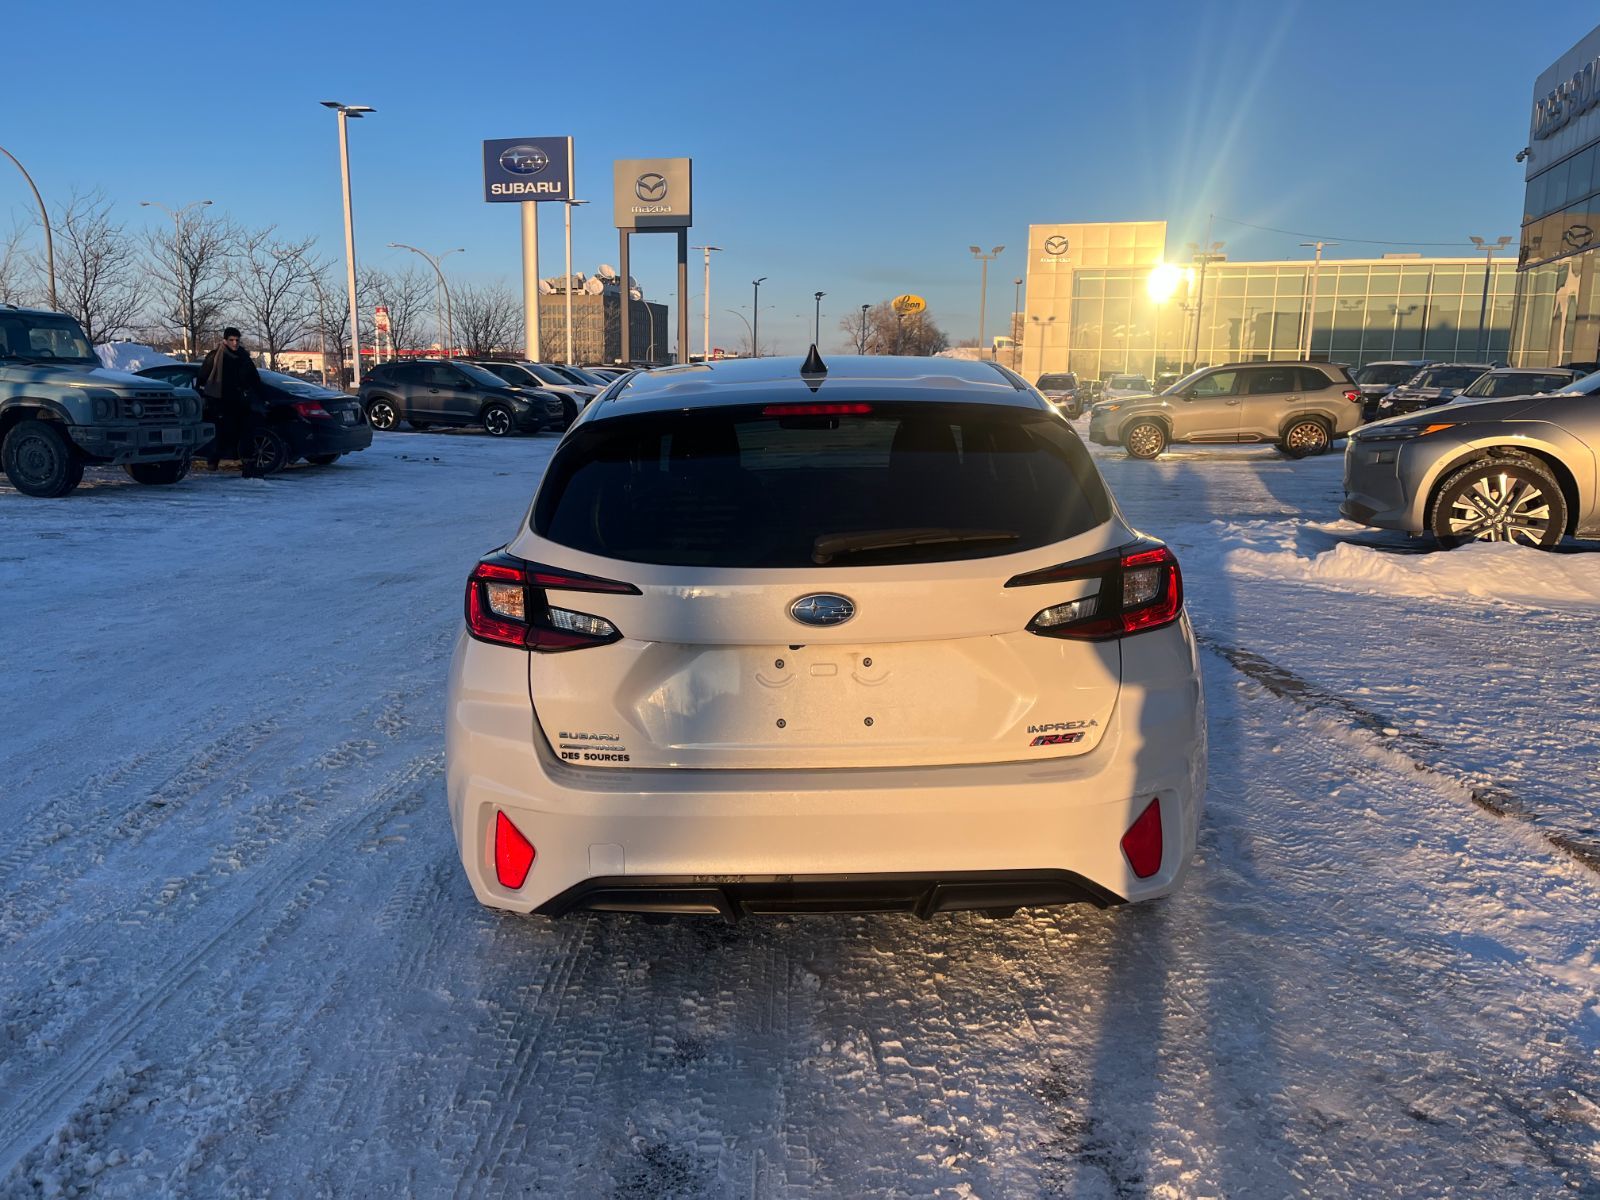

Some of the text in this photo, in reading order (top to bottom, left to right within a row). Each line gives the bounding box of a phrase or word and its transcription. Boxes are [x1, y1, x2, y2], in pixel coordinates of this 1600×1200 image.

[491, 181, 562, 195] SUBARU
[631, 205, 672, 213] mazda
[1027, 719, 1098, 733] IMPREZA
[559, 732, 620, 741] SUBARU
[561, 752, 630, 762] DES SOURCES
